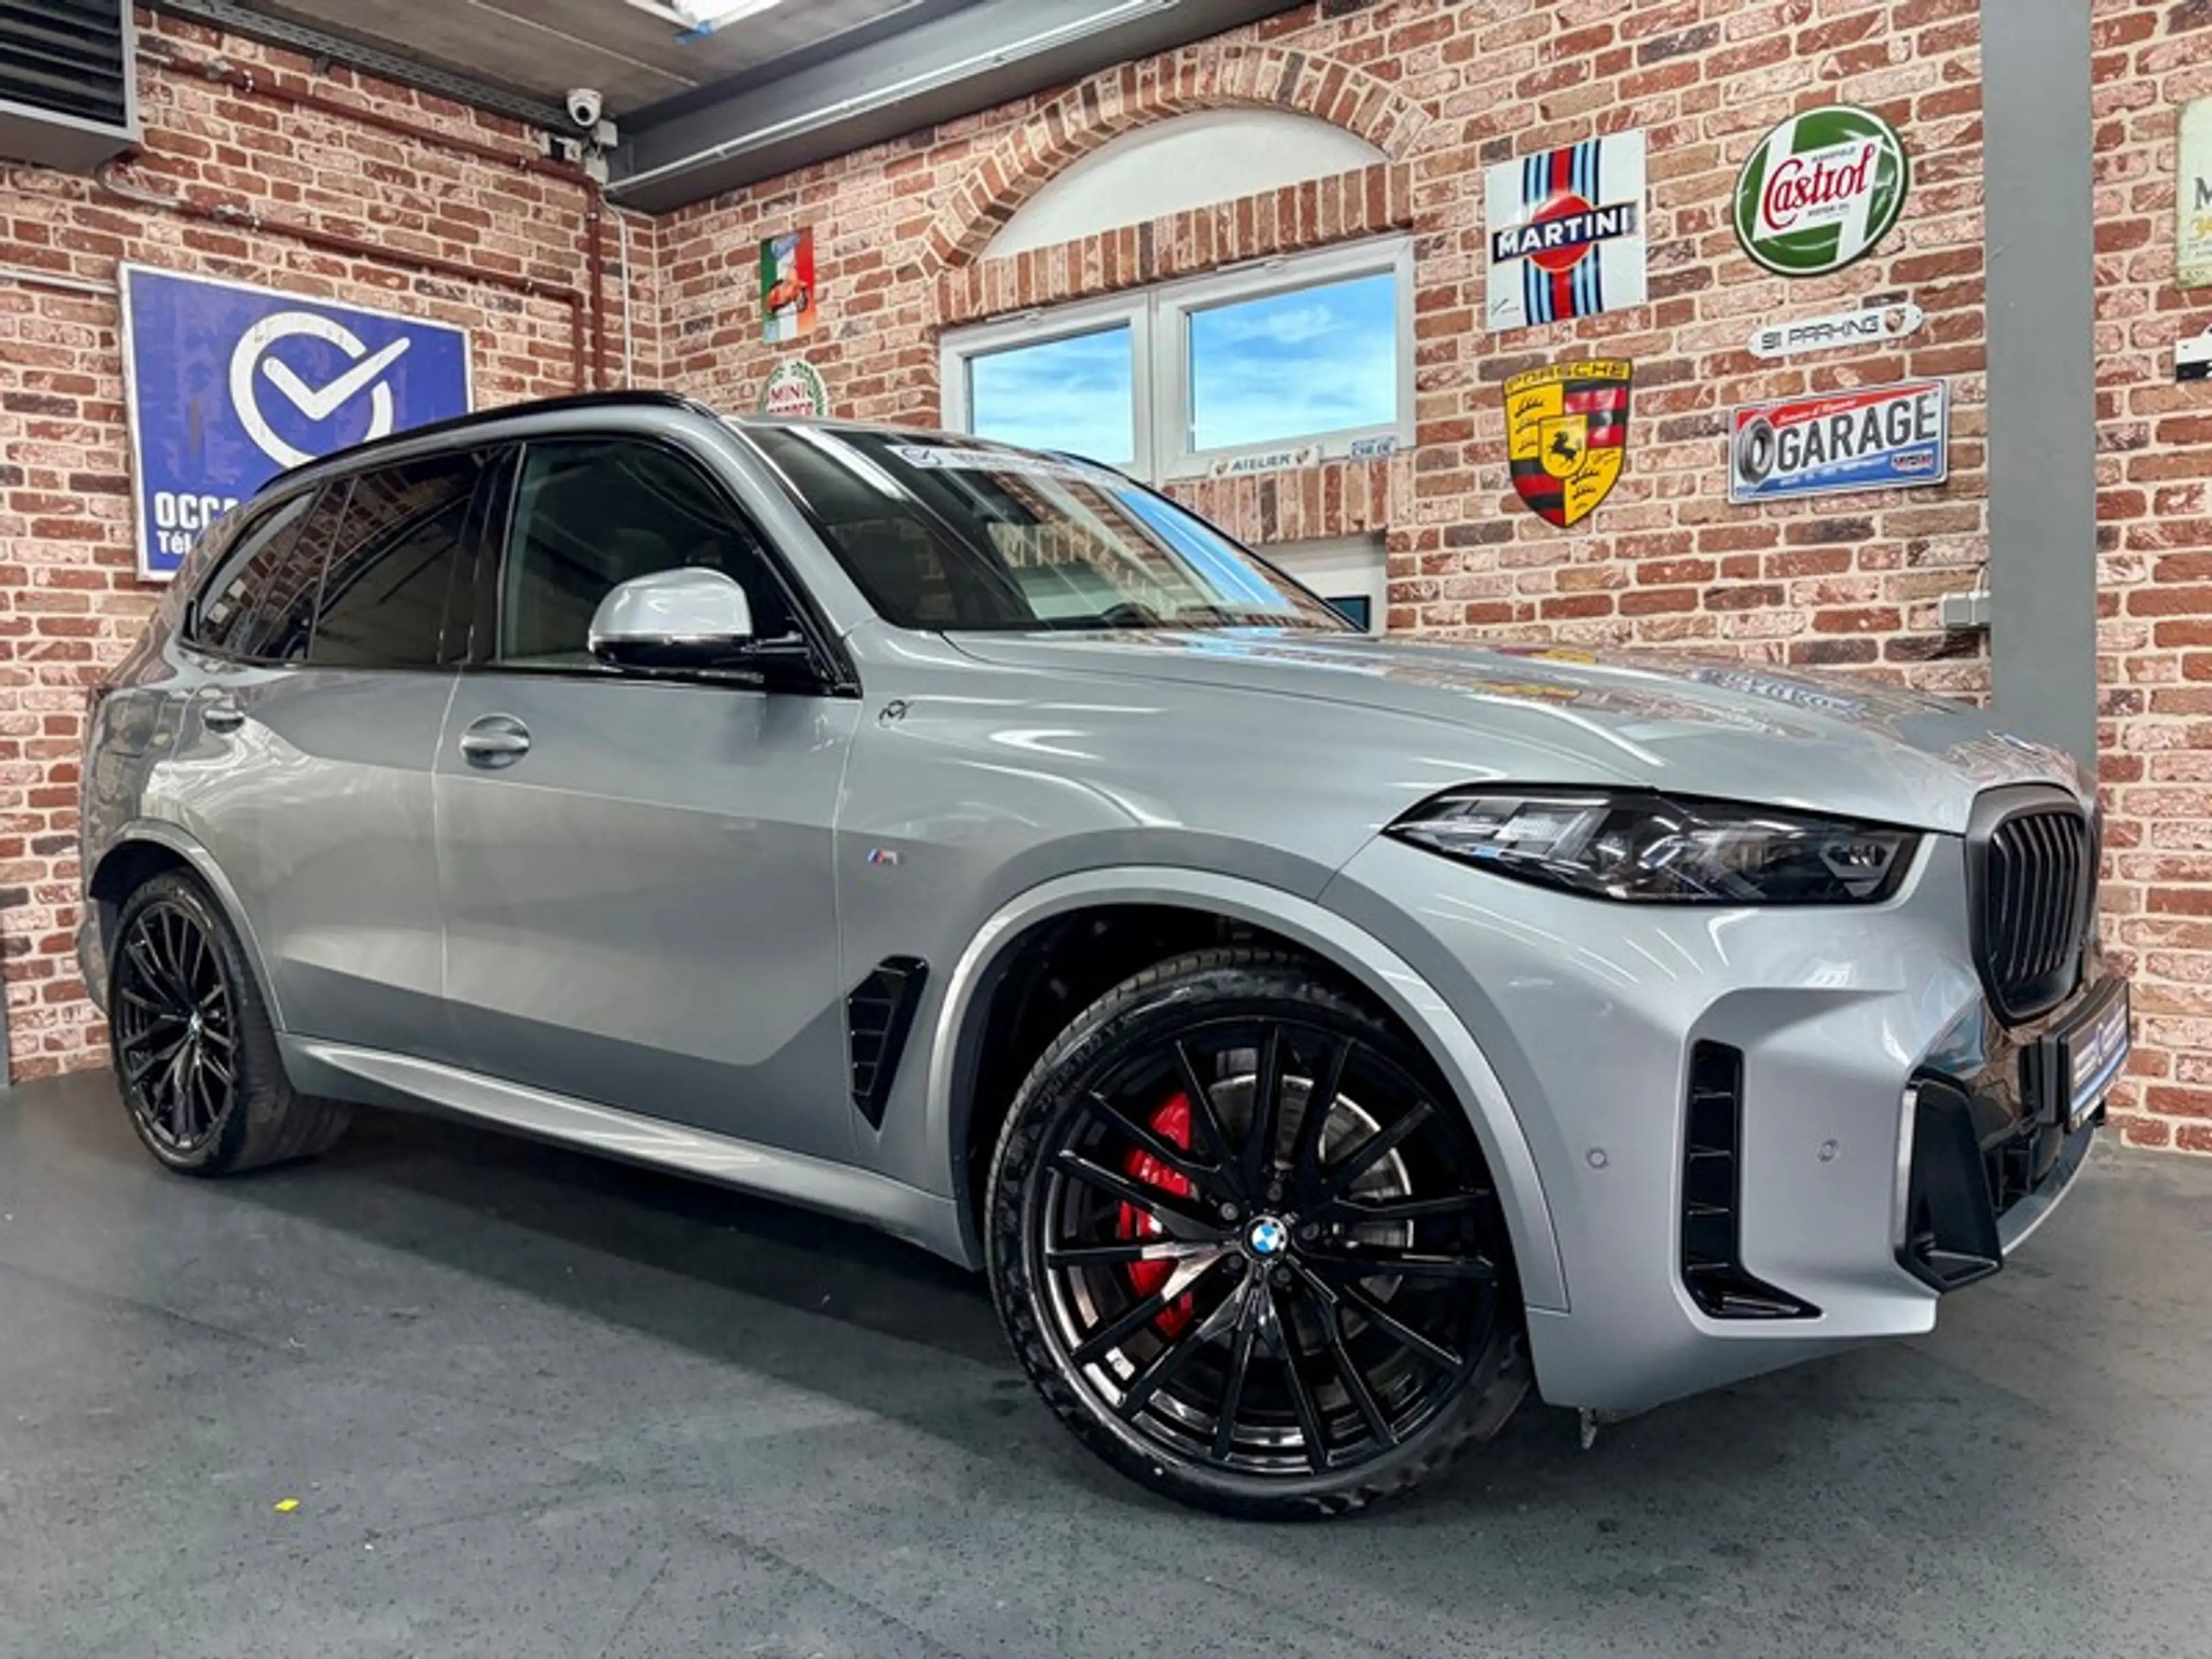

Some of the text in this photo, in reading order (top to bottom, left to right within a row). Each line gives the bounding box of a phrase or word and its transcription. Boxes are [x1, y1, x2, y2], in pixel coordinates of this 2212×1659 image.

[1763, 144, 1876, 229] Castrol
[1498, 207, 1629, 259] MARTINI
[1789, 315, 1879, 345] PARKING
[1505, 361, 1627, 393] PORSCHE
[1778, 393, 1937, 471] GARAGE
